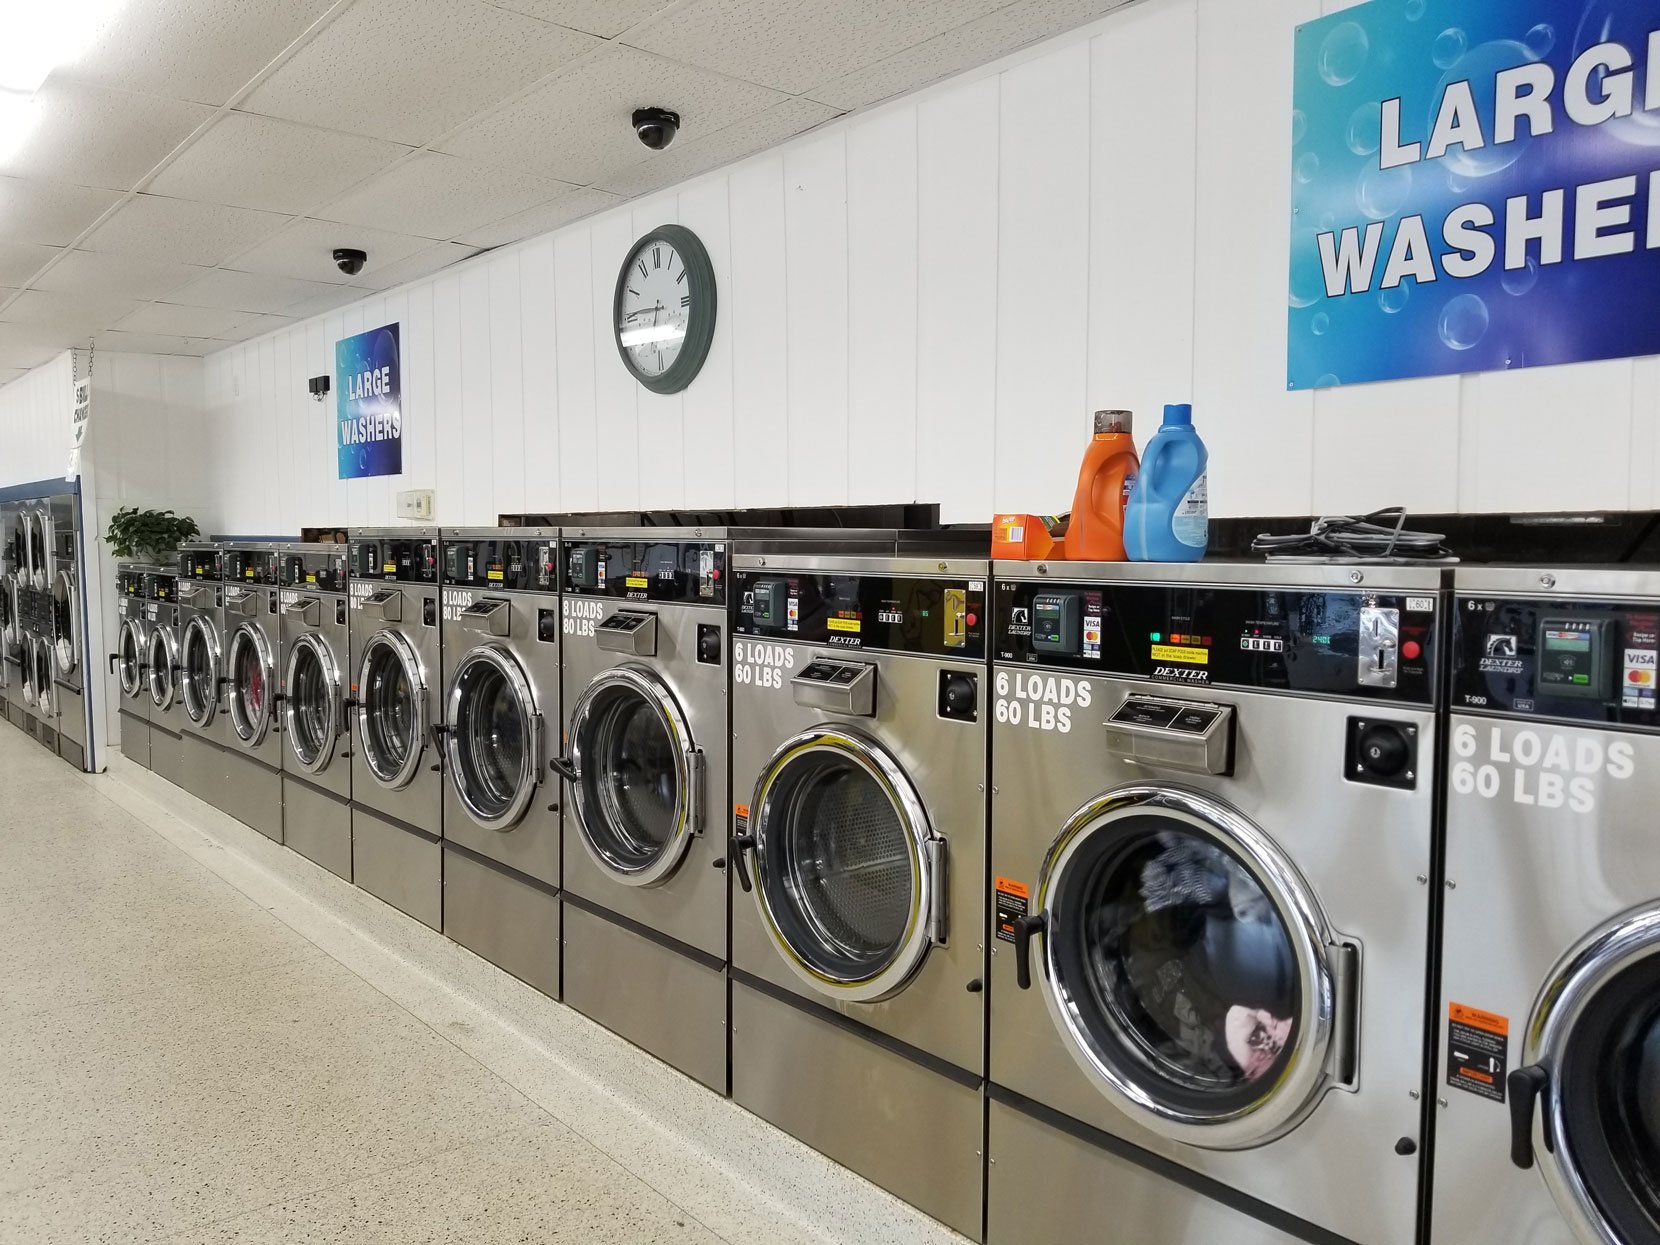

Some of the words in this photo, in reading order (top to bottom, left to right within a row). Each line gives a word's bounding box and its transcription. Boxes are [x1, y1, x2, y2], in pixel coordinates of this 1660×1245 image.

[1379, 28, 1660, 171] LARG
[1316, 171, 1660, 298] WASHE
[348, 366, 390, 401] LARGE
[341, 412, 402, 446] WASHERS
[355, 584, 372, 596] LOADS
[443, 591, 448, 604] 8
[449, 591, 472, 606] LOADS
[443, 606, 452, 620] 80
[453, 607, 466, 621] LB
[563, 601, 569, 616] 8
[572, 601, 603, 620] LOADS
[1468, 601, 1475, 610] 6
[563, 618, 574, 634] 80
[577, 619, 595, 637] LBS
[829, 636, 860, 645] DEXTER
[735, 643, 743, 661] 6
[747, 643, 794, 668] LOADS
[1479, 658, 1522, 667] DEXTER
[1627, 654, 1655, 664] VISA
[735, 664, 751, 684] 60
[755, 666, 782, 689] LBS
[1153, 667, 1208, 679] DEXTER
[1479, 665, 1524, 674] LAUNDRY
[996, 672, 1009, 696] 6
[1016, 673, 1092, 708] LOADS
[1465, 695, 1487, 705] T-900
[996, 699, 1021, 725] 60
[1028, 703, 1072, 733] LBS
[1454, 724, 1477, 757] 6
[1490, 727, 1634, 779] LOADS
[1452, 761, 1500, 798] 60
[1514, 768, 1595, 814] LBS
